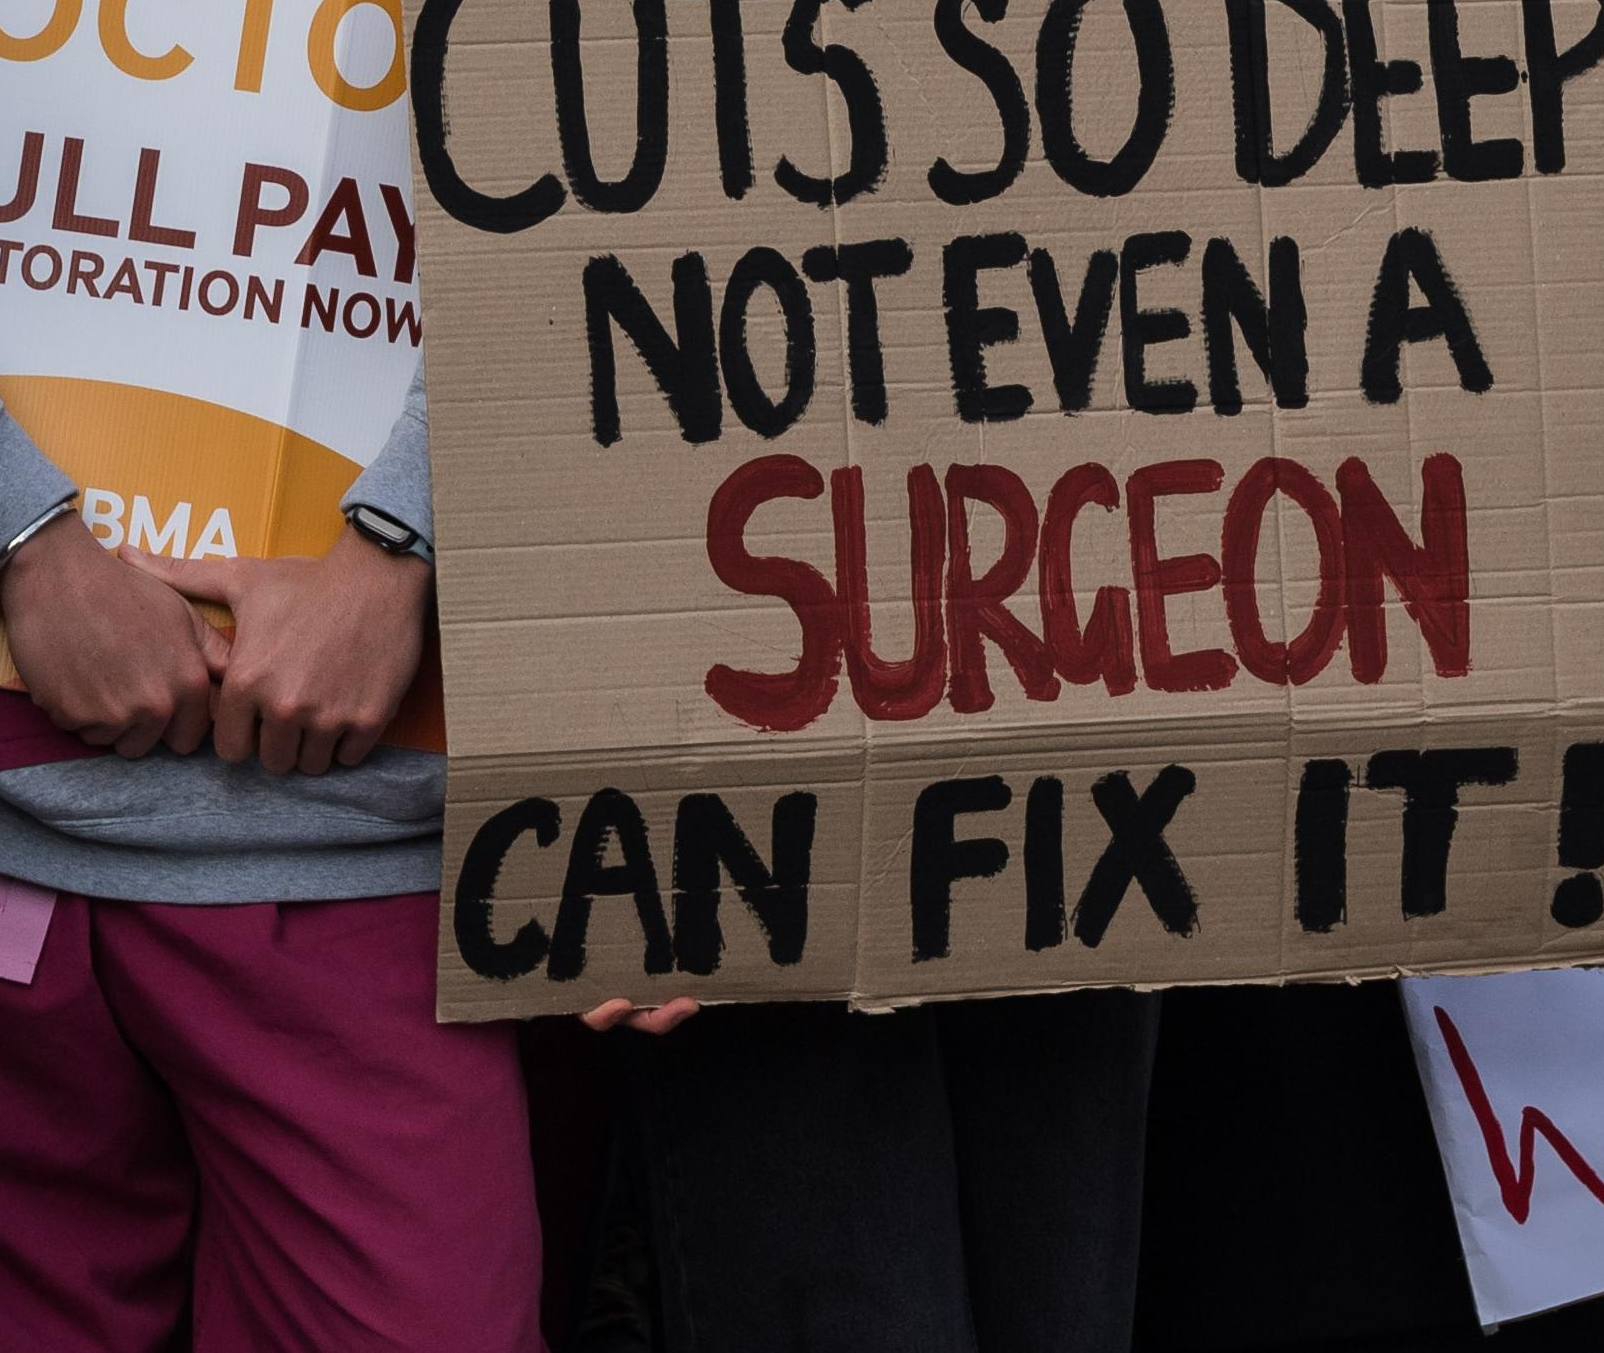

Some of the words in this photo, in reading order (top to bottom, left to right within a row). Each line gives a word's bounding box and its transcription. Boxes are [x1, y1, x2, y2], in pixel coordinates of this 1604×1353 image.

[300, 283, 426, 349] NOW
[583, 237, 914, 447] NOT
[943, 229, 1310, 425] EVEN
[1358, 225, 1496, 405] A
[81, 487, 238, 559] BMA
[704, 452, 1471, 733] SURGEON
[454, 787, 818, 982] CAN
[910, 764, 1198, 963] FIX
